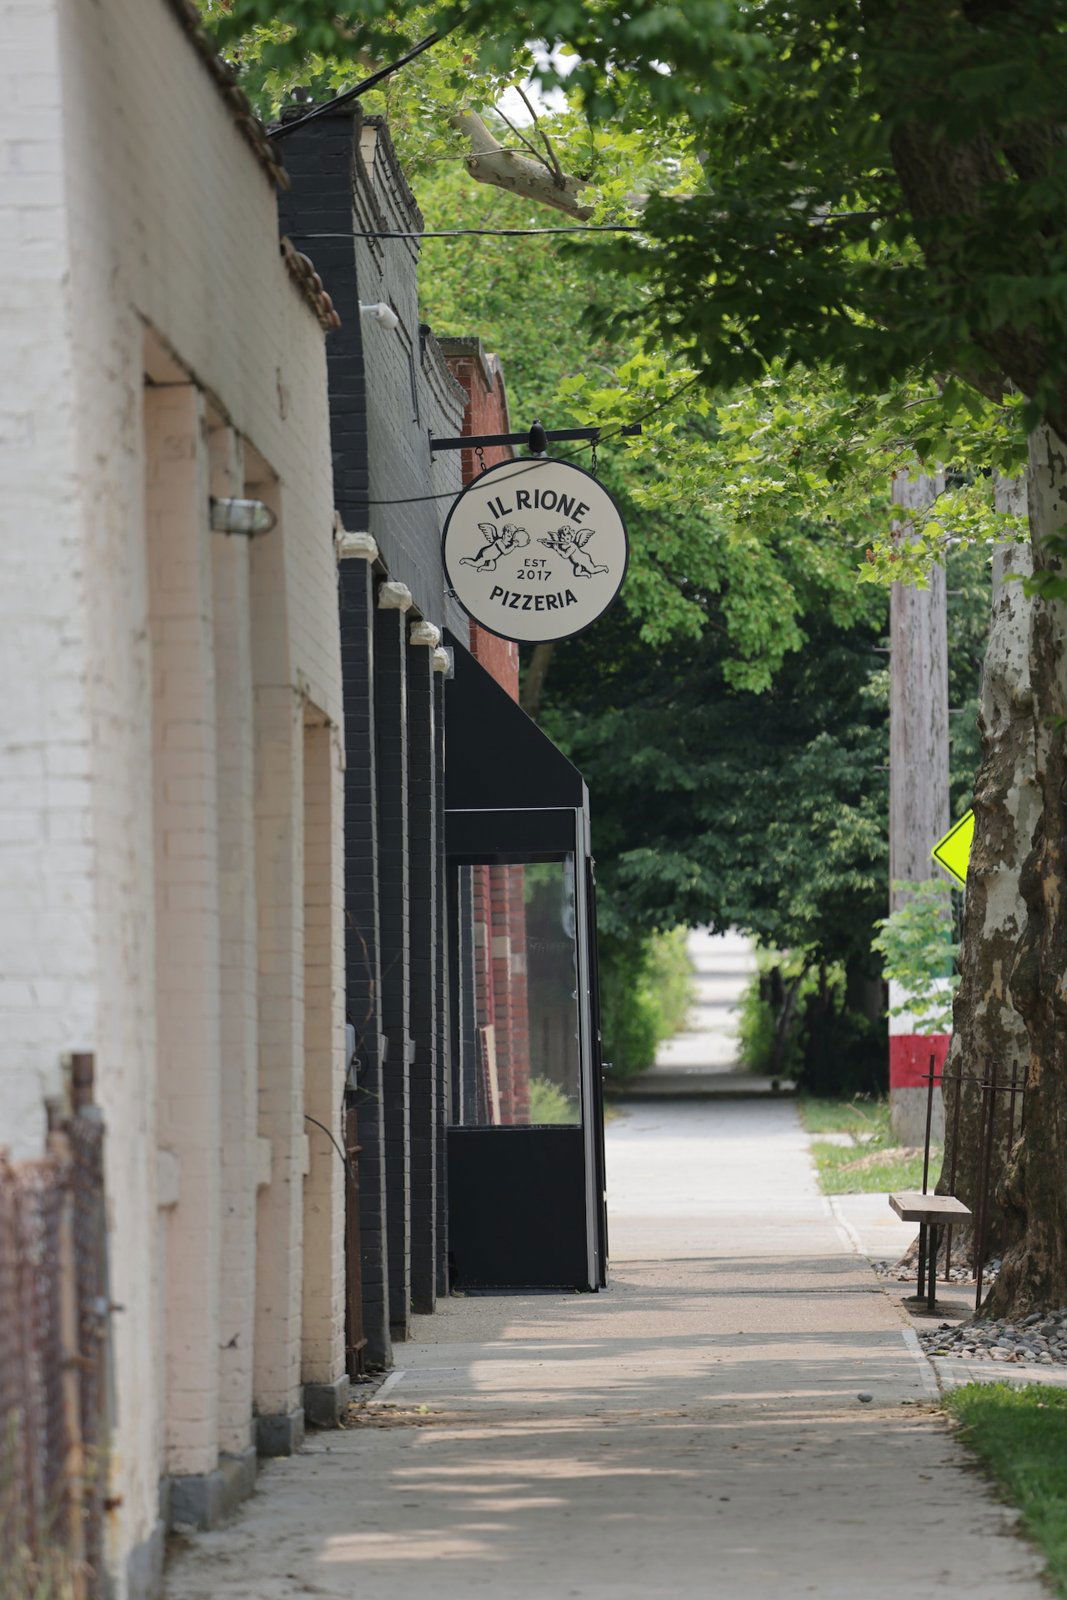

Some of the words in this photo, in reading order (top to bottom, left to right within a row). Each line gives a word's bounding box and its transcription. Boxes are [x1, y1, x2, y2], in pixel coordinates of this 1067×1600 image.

[487, 497, 512, 519] IL
[516, 489, 590, 523] RIONE
[524, 559, 547, 568] EST
[517, 570, 552, 581] 2017
[489, 585, 578, 611] PIZZERIA
